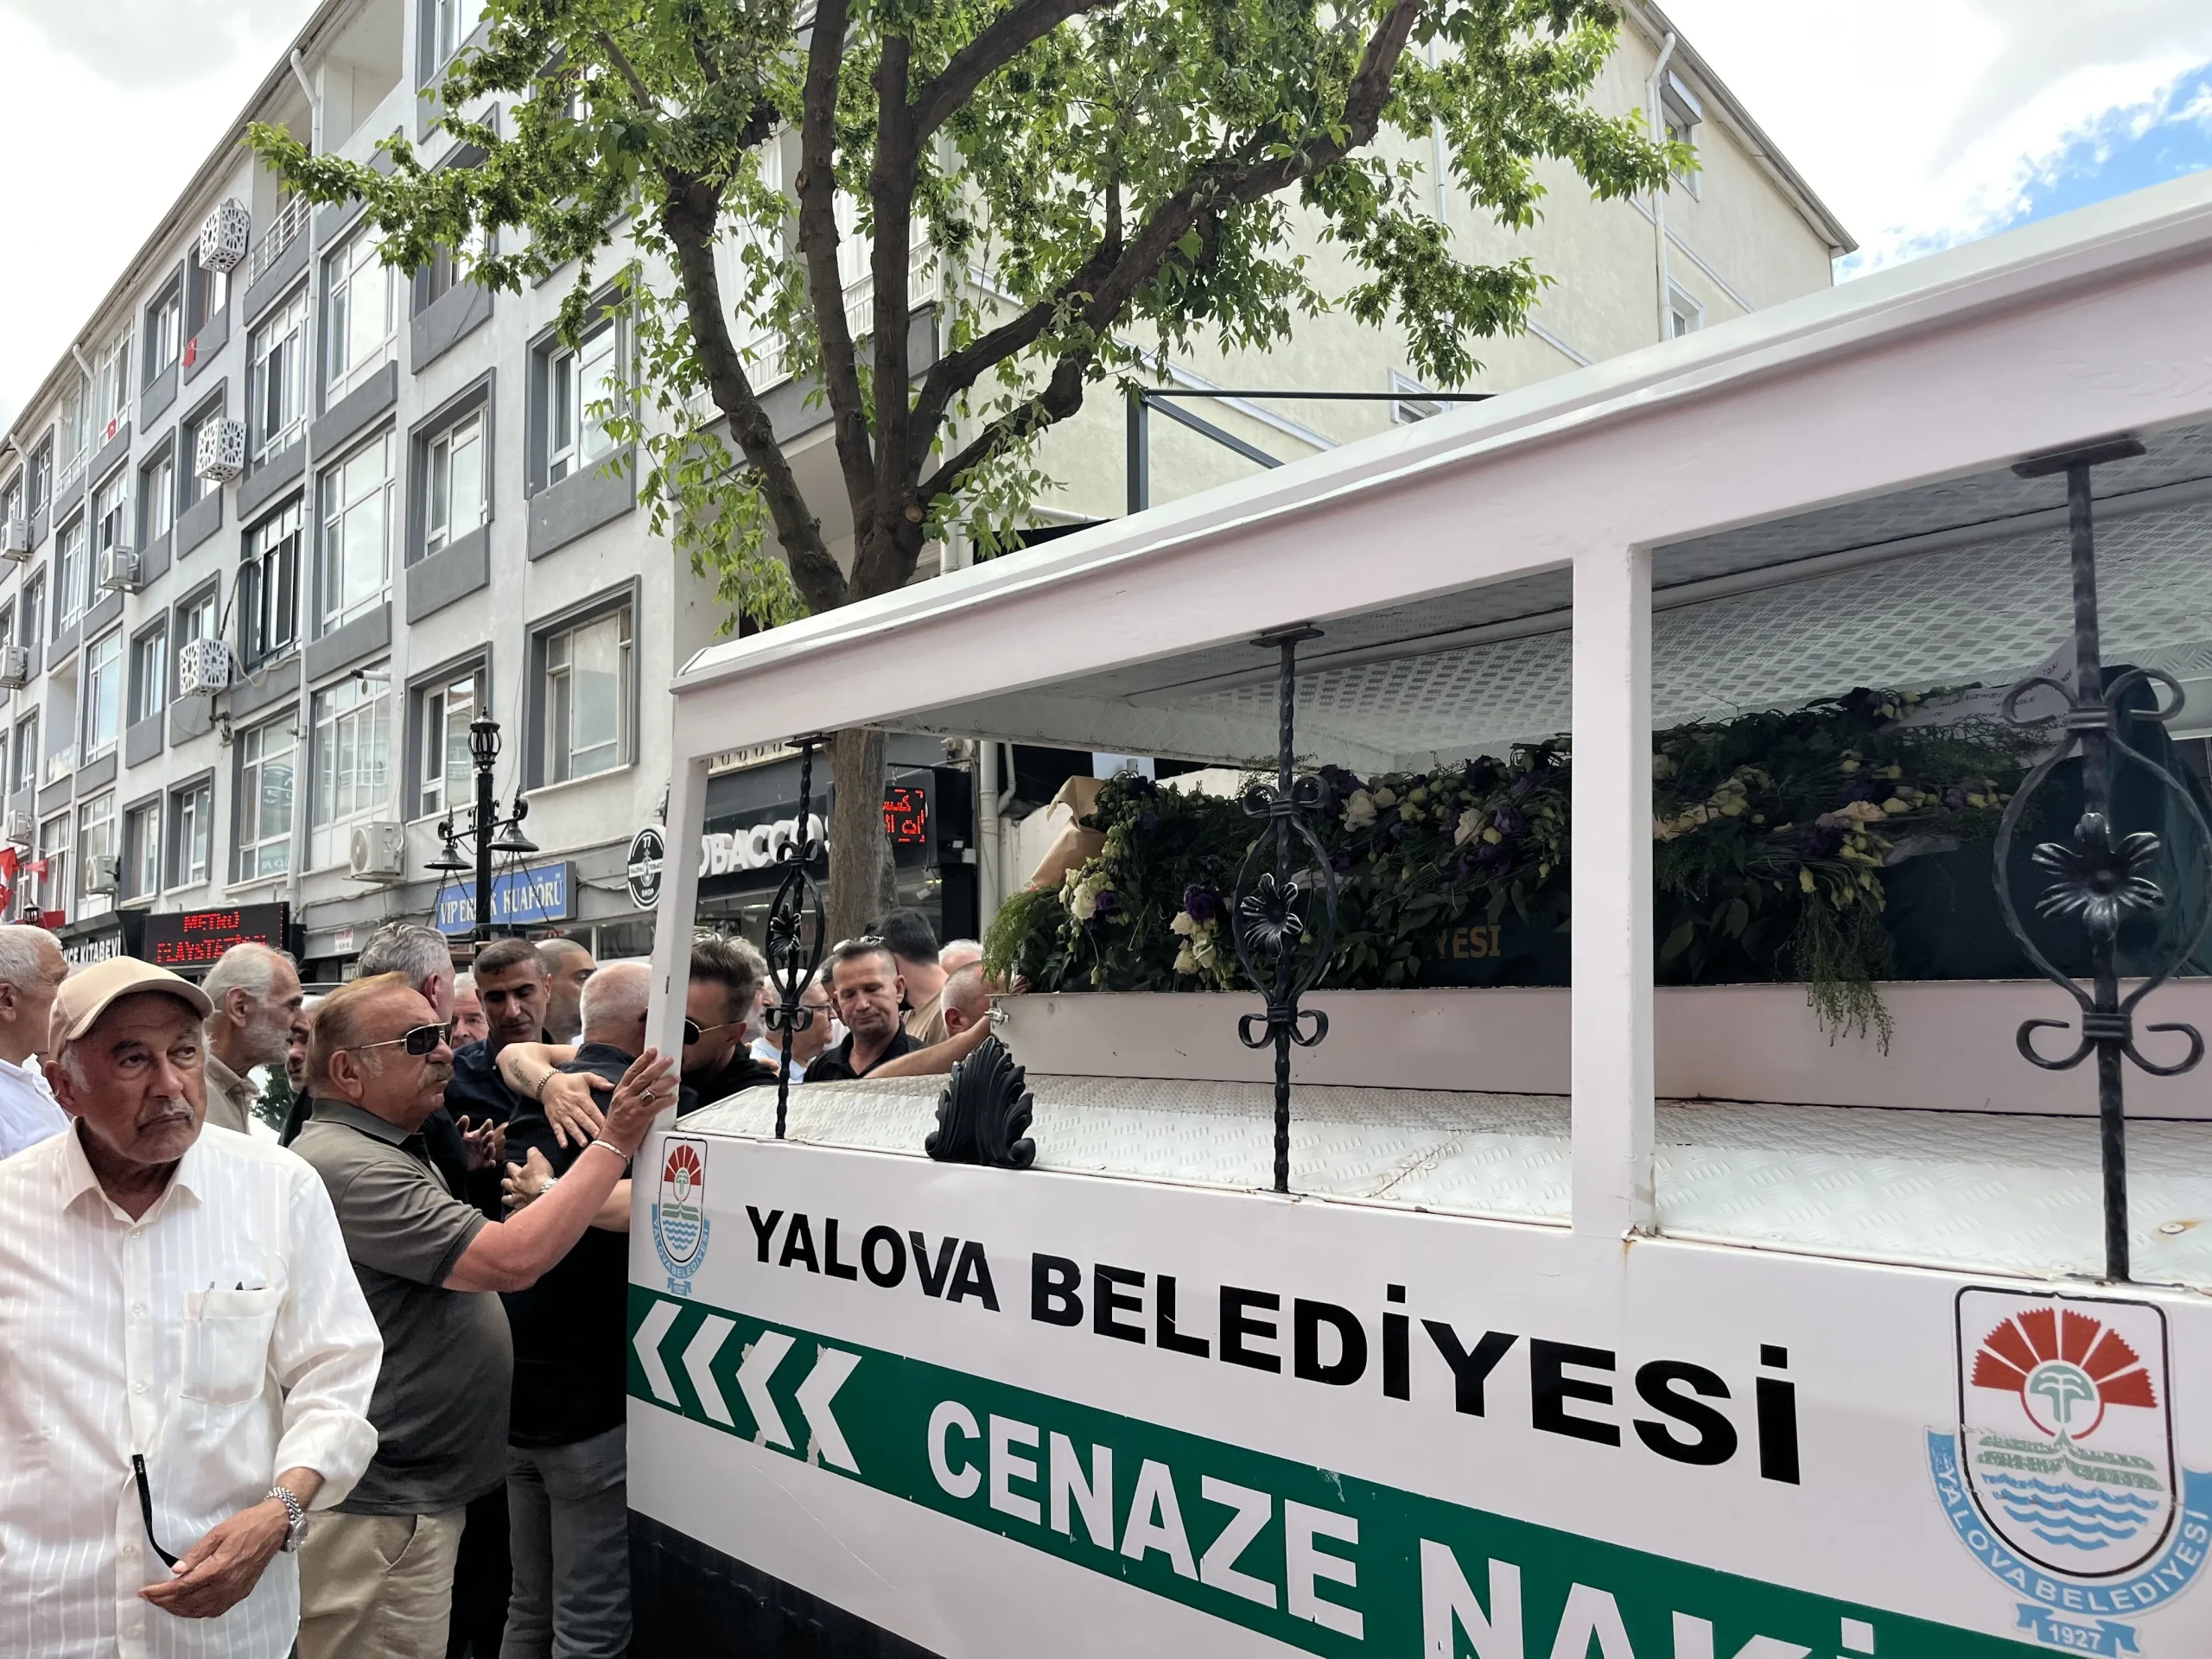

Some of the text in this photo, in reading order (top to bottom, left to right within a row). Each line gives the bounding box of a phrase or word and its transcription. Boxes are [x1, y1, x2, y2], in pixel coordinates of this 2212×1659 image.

[459, 893, 498, 923] ERK
[503, 874, 563, 914] KUAFÖRÜ
[641, 887, 655, 898] SHOP
[80, 929, 121, 963] KİTABEVİ
[745, 1205, 1801, 1485] YALOVA BELEDİYESİ
[927, 1400, 1364, 1641] CENAZE
[1936, 1469, 2027, 1590] YALOVA
[2047, 1624, 2102, 1651] 1927
